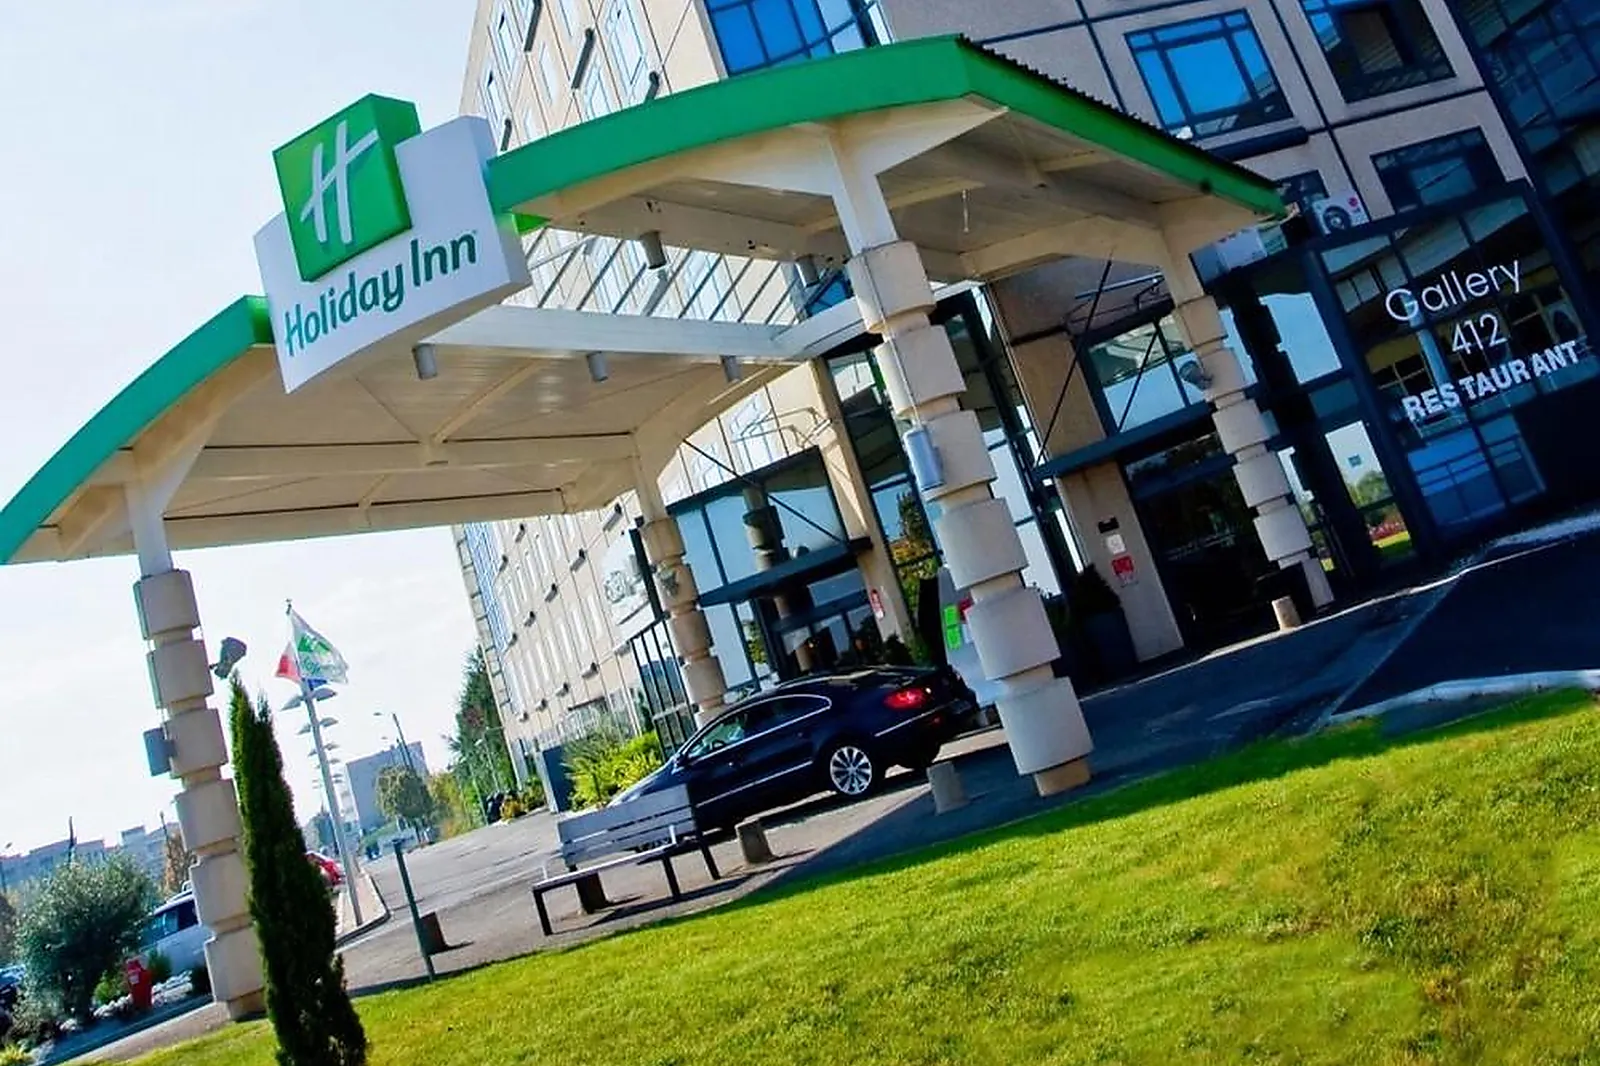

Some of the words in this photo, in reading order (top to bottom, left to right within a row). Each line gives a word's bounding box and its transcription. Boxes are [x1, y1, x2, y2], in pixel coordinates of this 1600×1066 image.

[285, 264, 404, 357] Holiday
[410, 233, 476, 287] Inn
[1385, 260, 1520, 321] Gallery
[1452, 313, 1507, 355] 412
[1401, 340, 1580, 421] RESTAURANT
